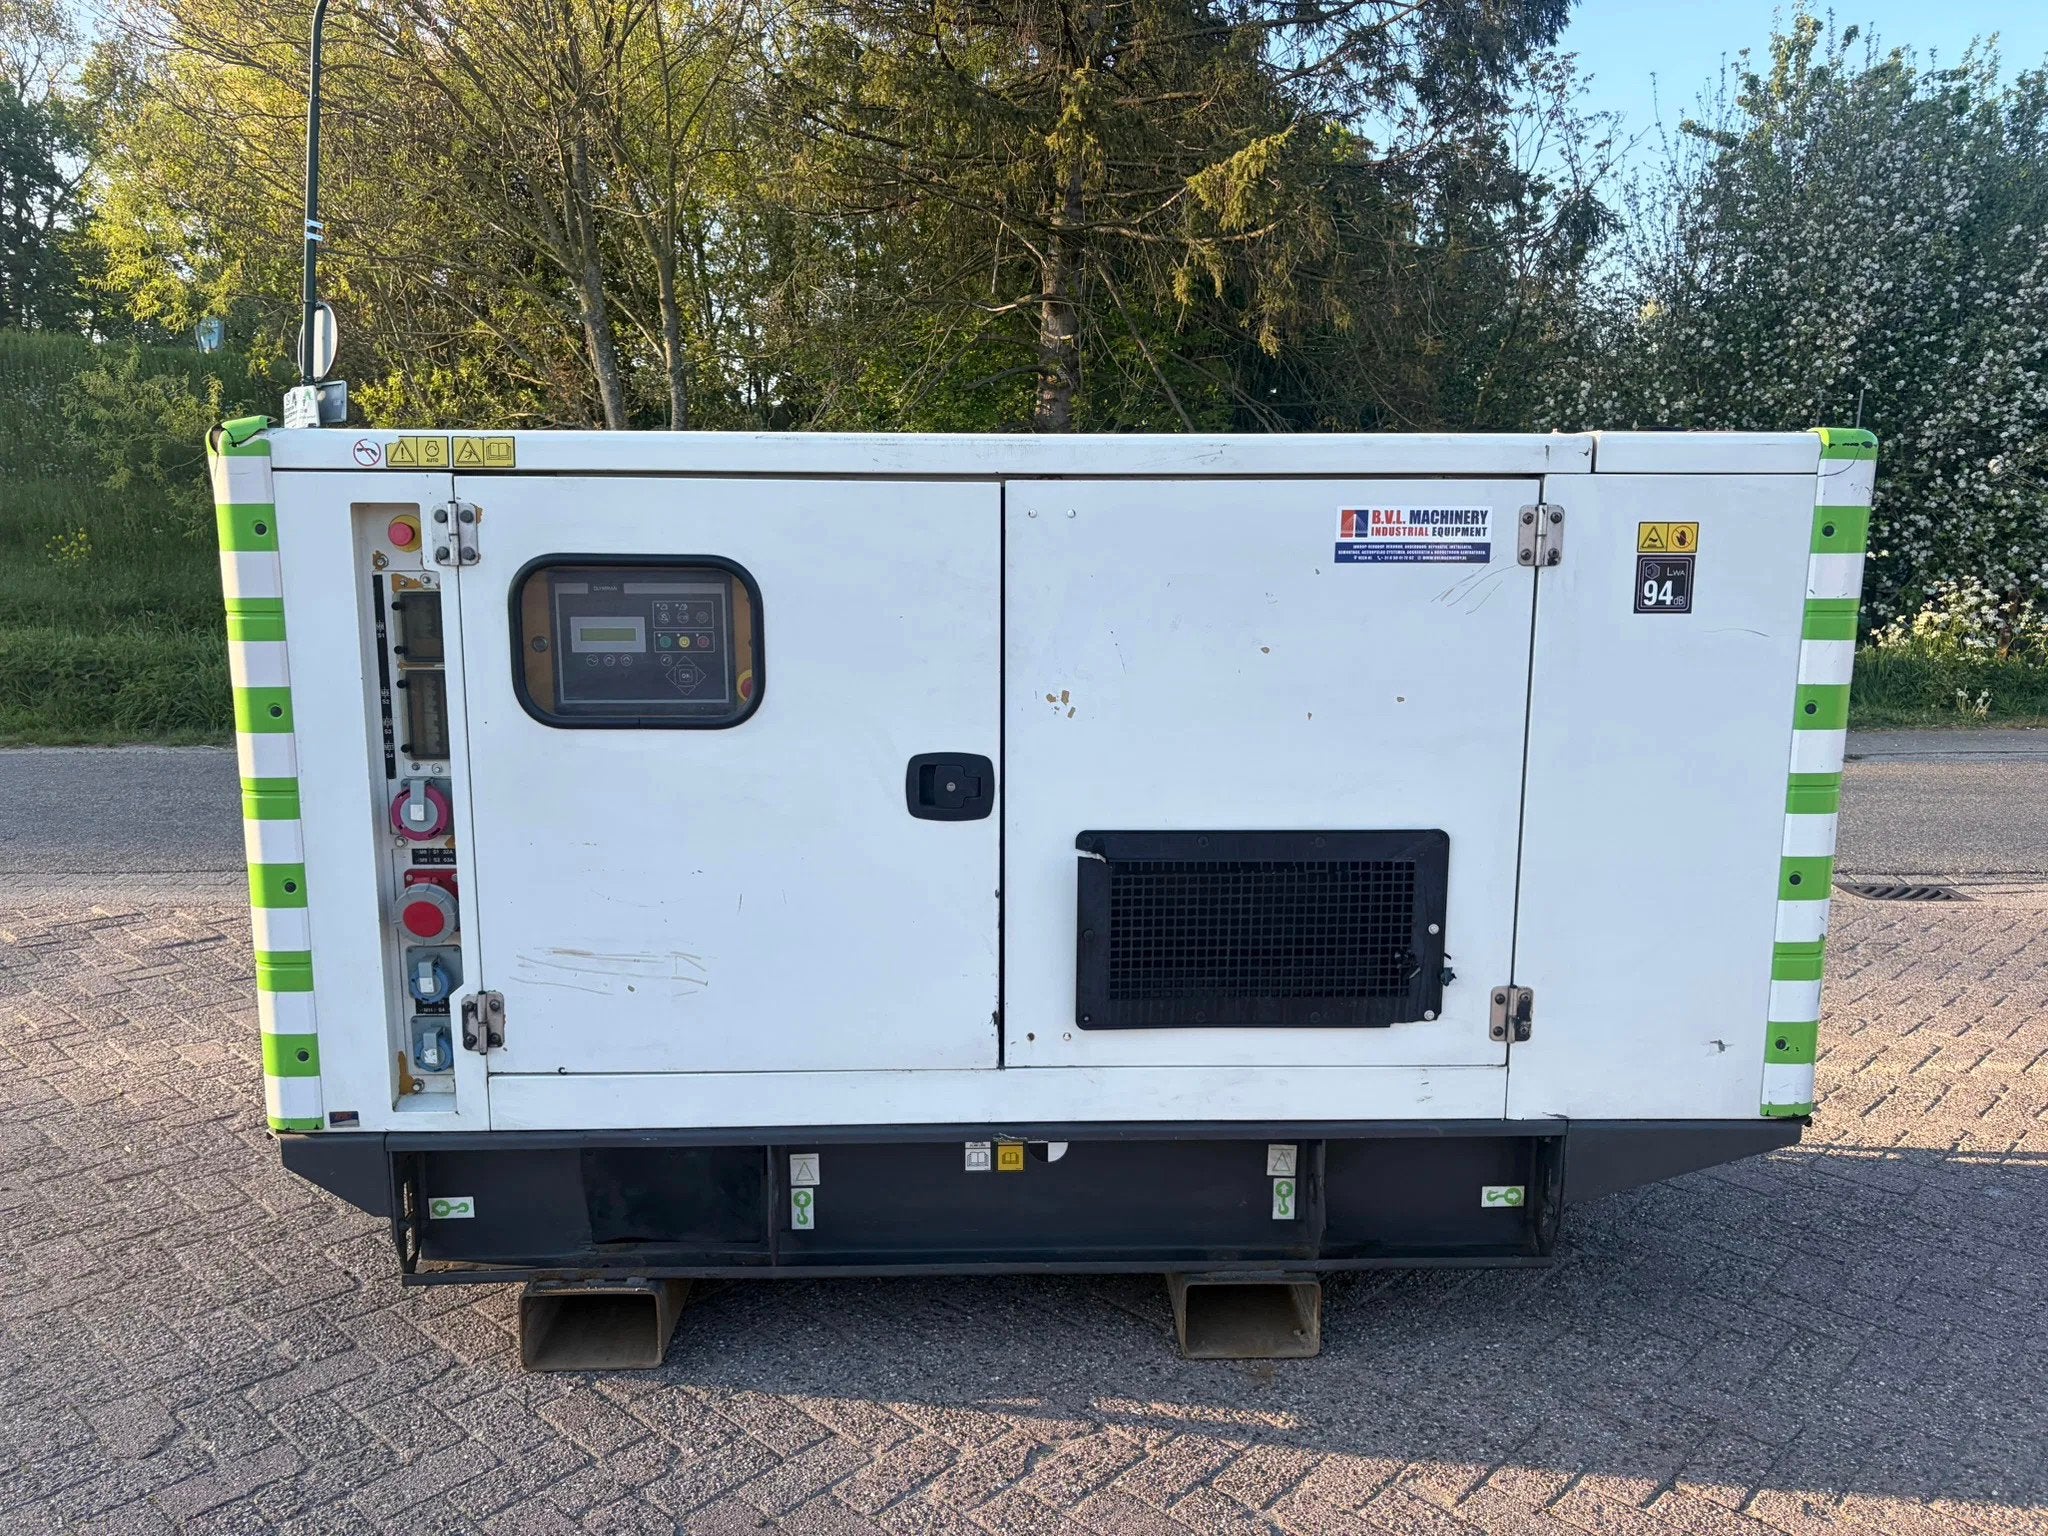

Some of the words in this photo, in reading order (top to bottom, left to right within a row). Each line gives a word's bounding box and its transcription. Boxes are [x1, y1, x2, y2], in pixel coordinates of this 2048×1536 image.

[1371, 510, 1406, 525] B.V.L.
[1409, 510, 1489, 525] MACHINERY
[1371, 526, 1429, 537] INDUSTRIAL
[1432, 526, 1488, 537] EQUIPMENT
[1643, 580, 1673, 606] 94
